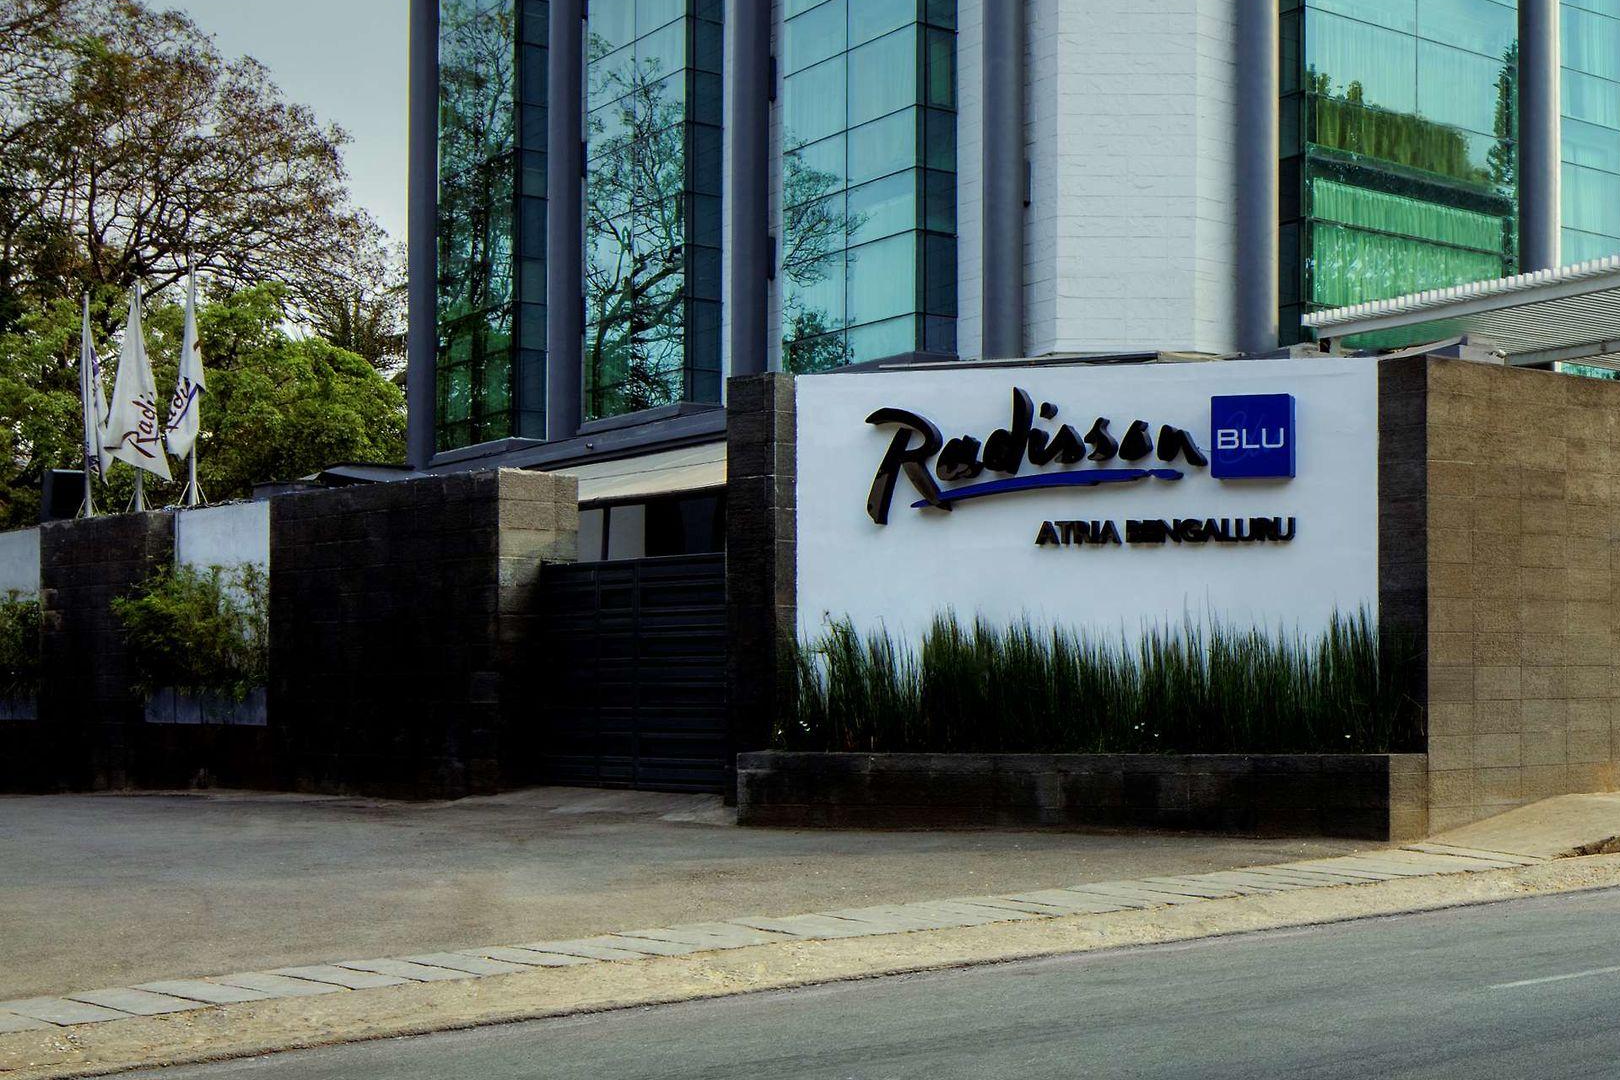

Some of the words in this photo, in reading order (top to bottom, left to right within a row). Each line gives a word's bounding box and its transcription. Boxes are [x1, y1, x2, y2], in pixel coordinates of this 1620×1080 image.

[865, 387, 1208, 525] Radisson
[1217, 427, 1285, 450] BLU
[1035, 520, 1122, 545] ATRIA
[1126, 517, 1296, 544] BENGALURU
